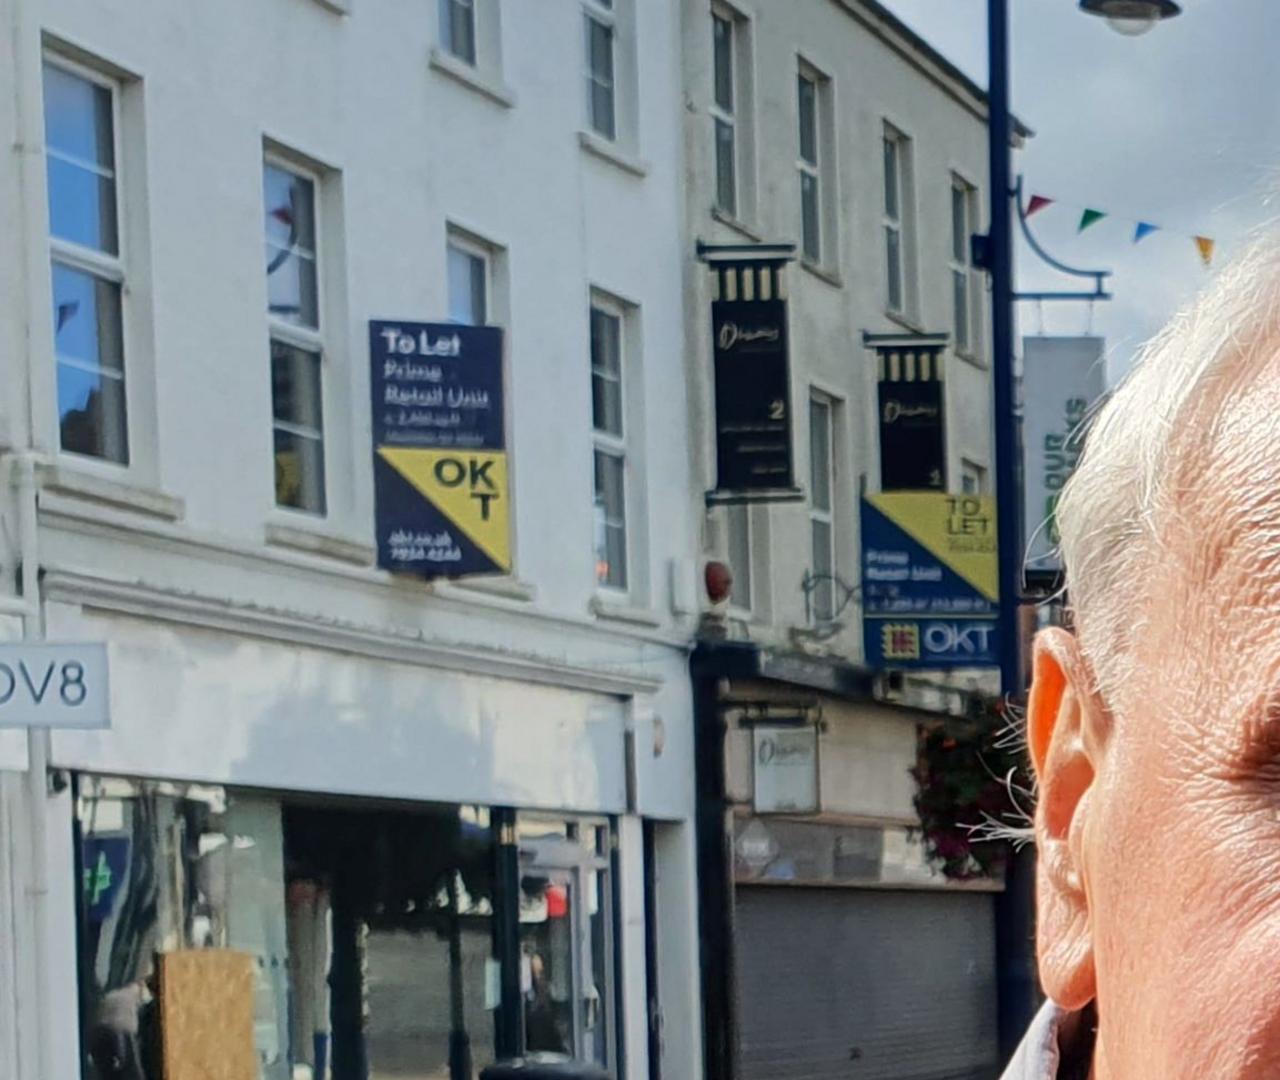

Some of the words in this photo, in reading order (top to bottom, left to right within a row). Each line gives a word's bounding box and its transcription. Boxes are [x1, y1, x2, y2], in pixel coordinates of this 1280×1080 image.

[381, 327, 416, 354] To
[420, 329, 460, 356] Let
[769, 400, 784, 419] 2
[945, 498, 981, 516] TO
[947, 517, 989, 535] LET
[924, 624, 994, 653] OKT
